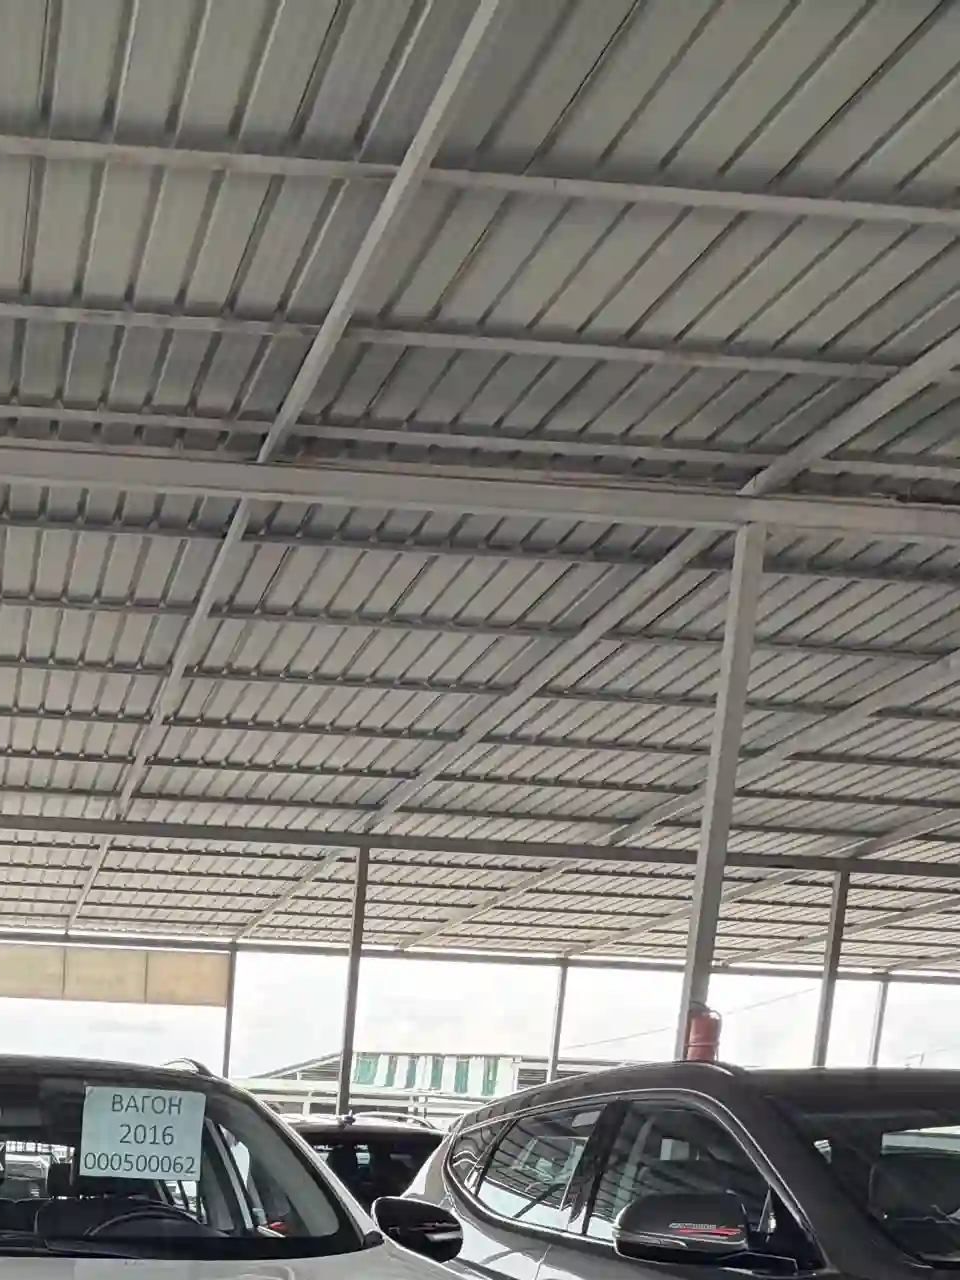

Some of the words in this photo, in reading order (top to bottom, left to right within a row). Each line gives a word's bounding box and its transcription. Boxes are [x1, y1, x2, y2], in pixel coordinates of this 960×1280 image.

[111, 1094, 182, 1115] ВАГОН
[119, 1124, 174, 1145] 2016
[84, 1152, 197, 1174] 000500062
